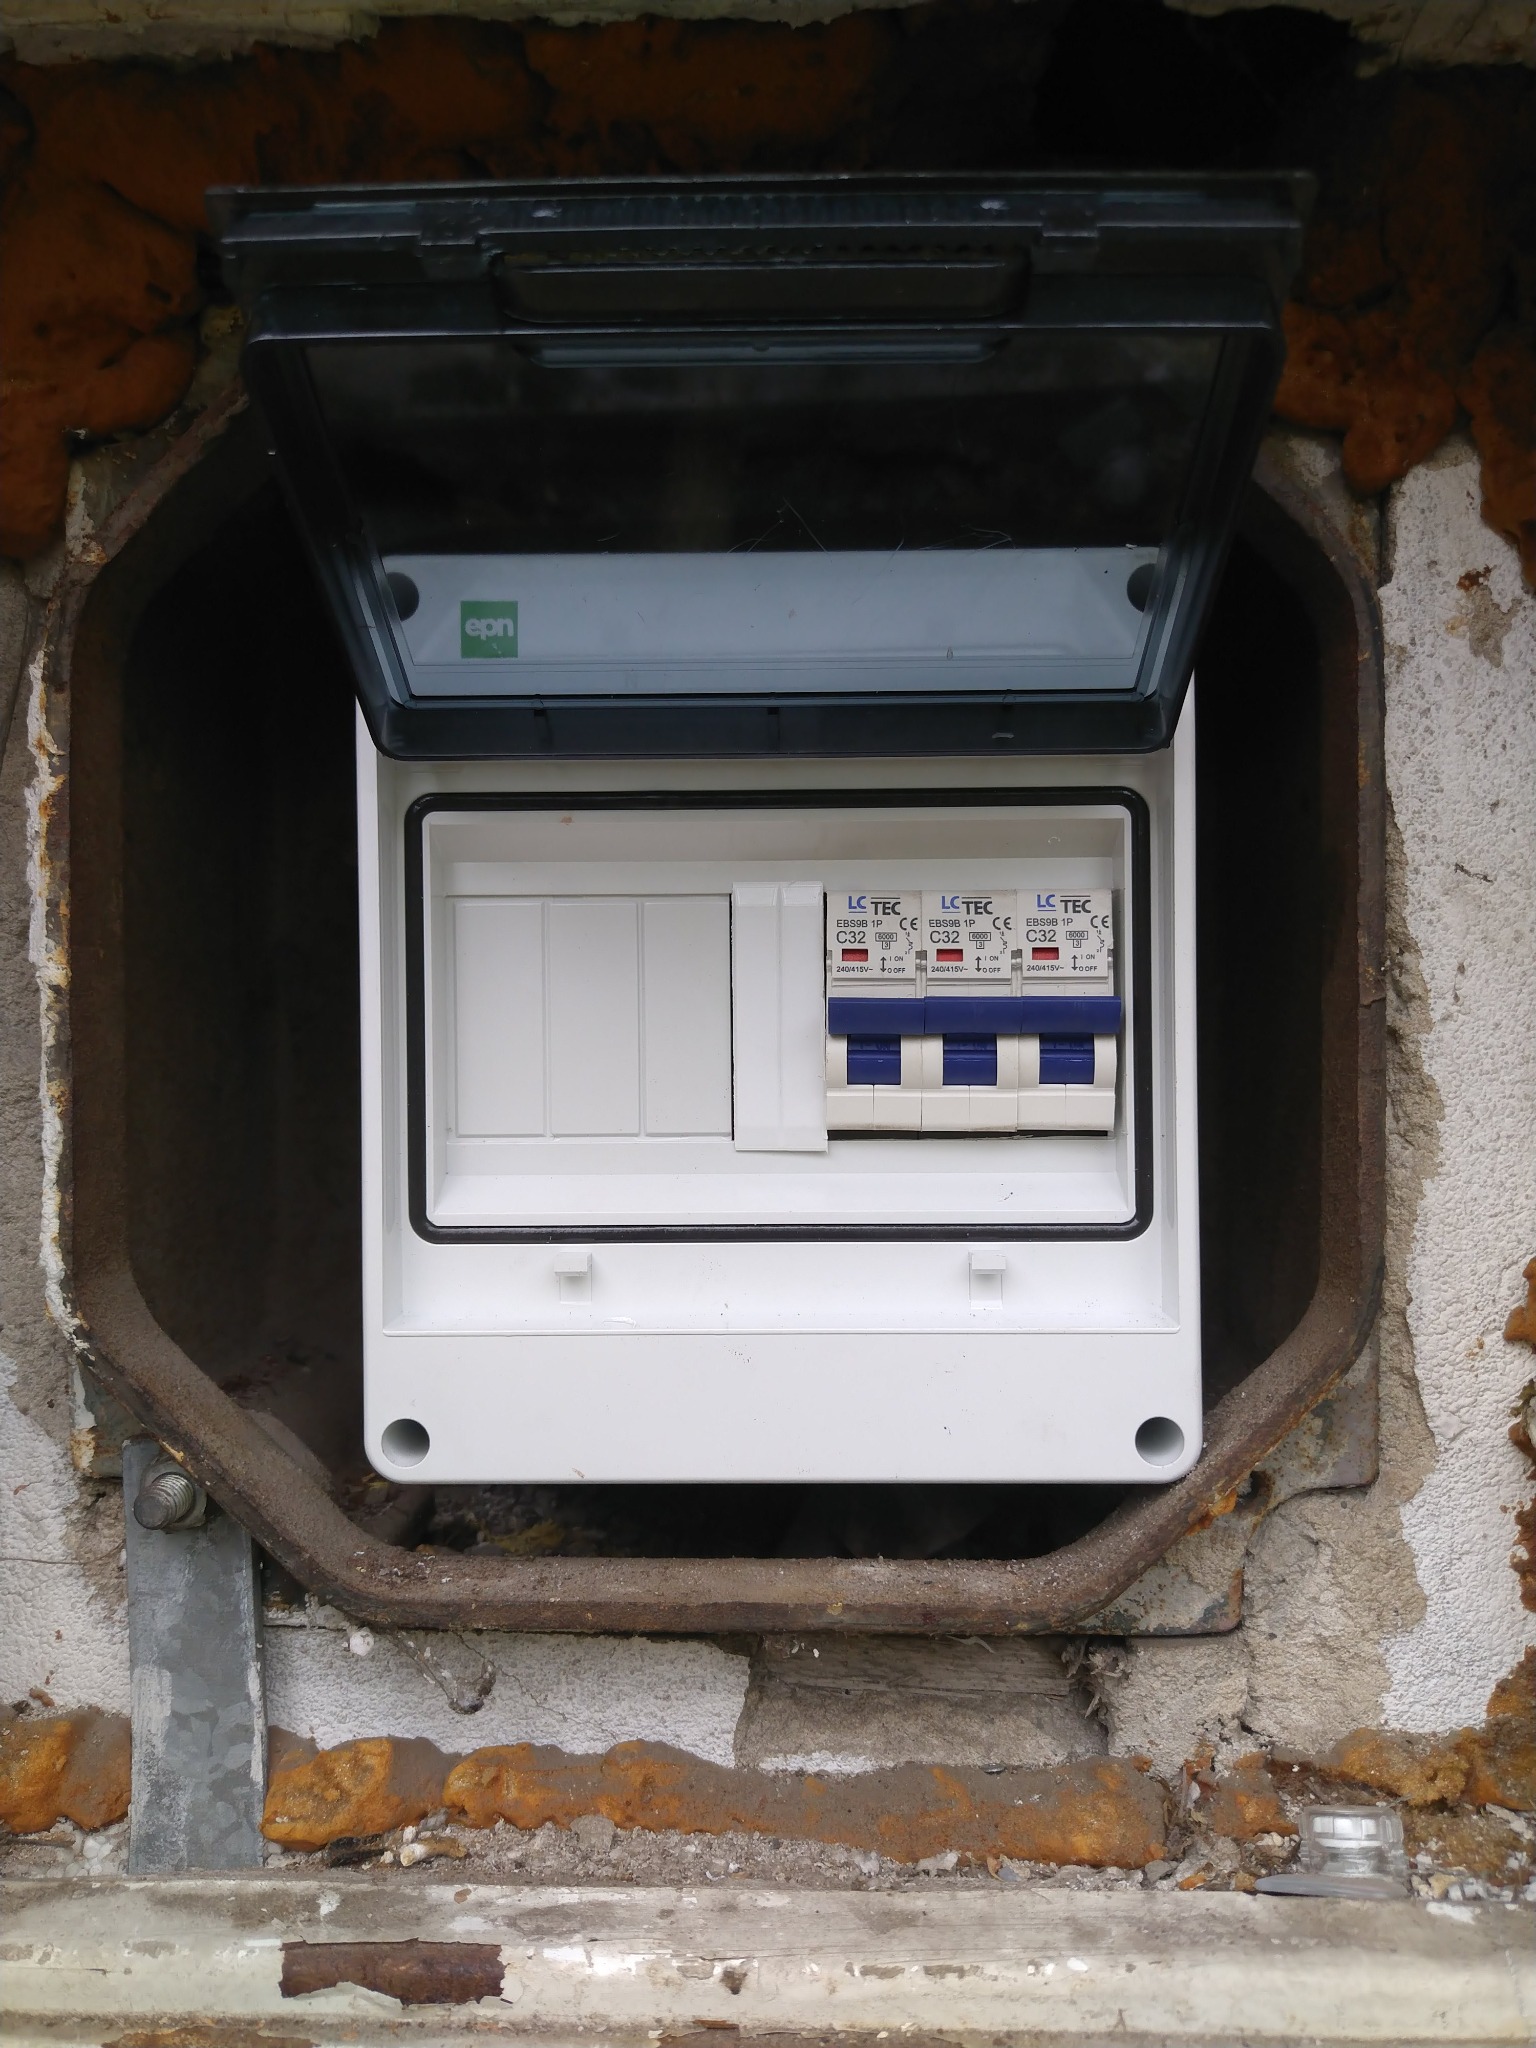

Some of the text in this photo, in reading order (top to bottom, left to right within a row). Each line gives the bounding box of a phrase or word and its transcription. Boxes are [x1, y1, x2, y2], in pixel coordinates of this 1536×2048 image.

[465, 618, 514, 641] epn
[848, 896, 901, 915] LC TEC
[942, 896, 993, 915] LC TEC
[1037, 894, 1091, 913] LC TEC
[836, 919, 883, 928] EBS9B 1P
[929, 919, 975, 928] EBS9B 1P
[1026, 918, 1073, 927] EBS9B 1P
[836, 931, 866, 944] C32
[930, 931, 960, 943] C32
[1026, 929, 1056, 942] C32
